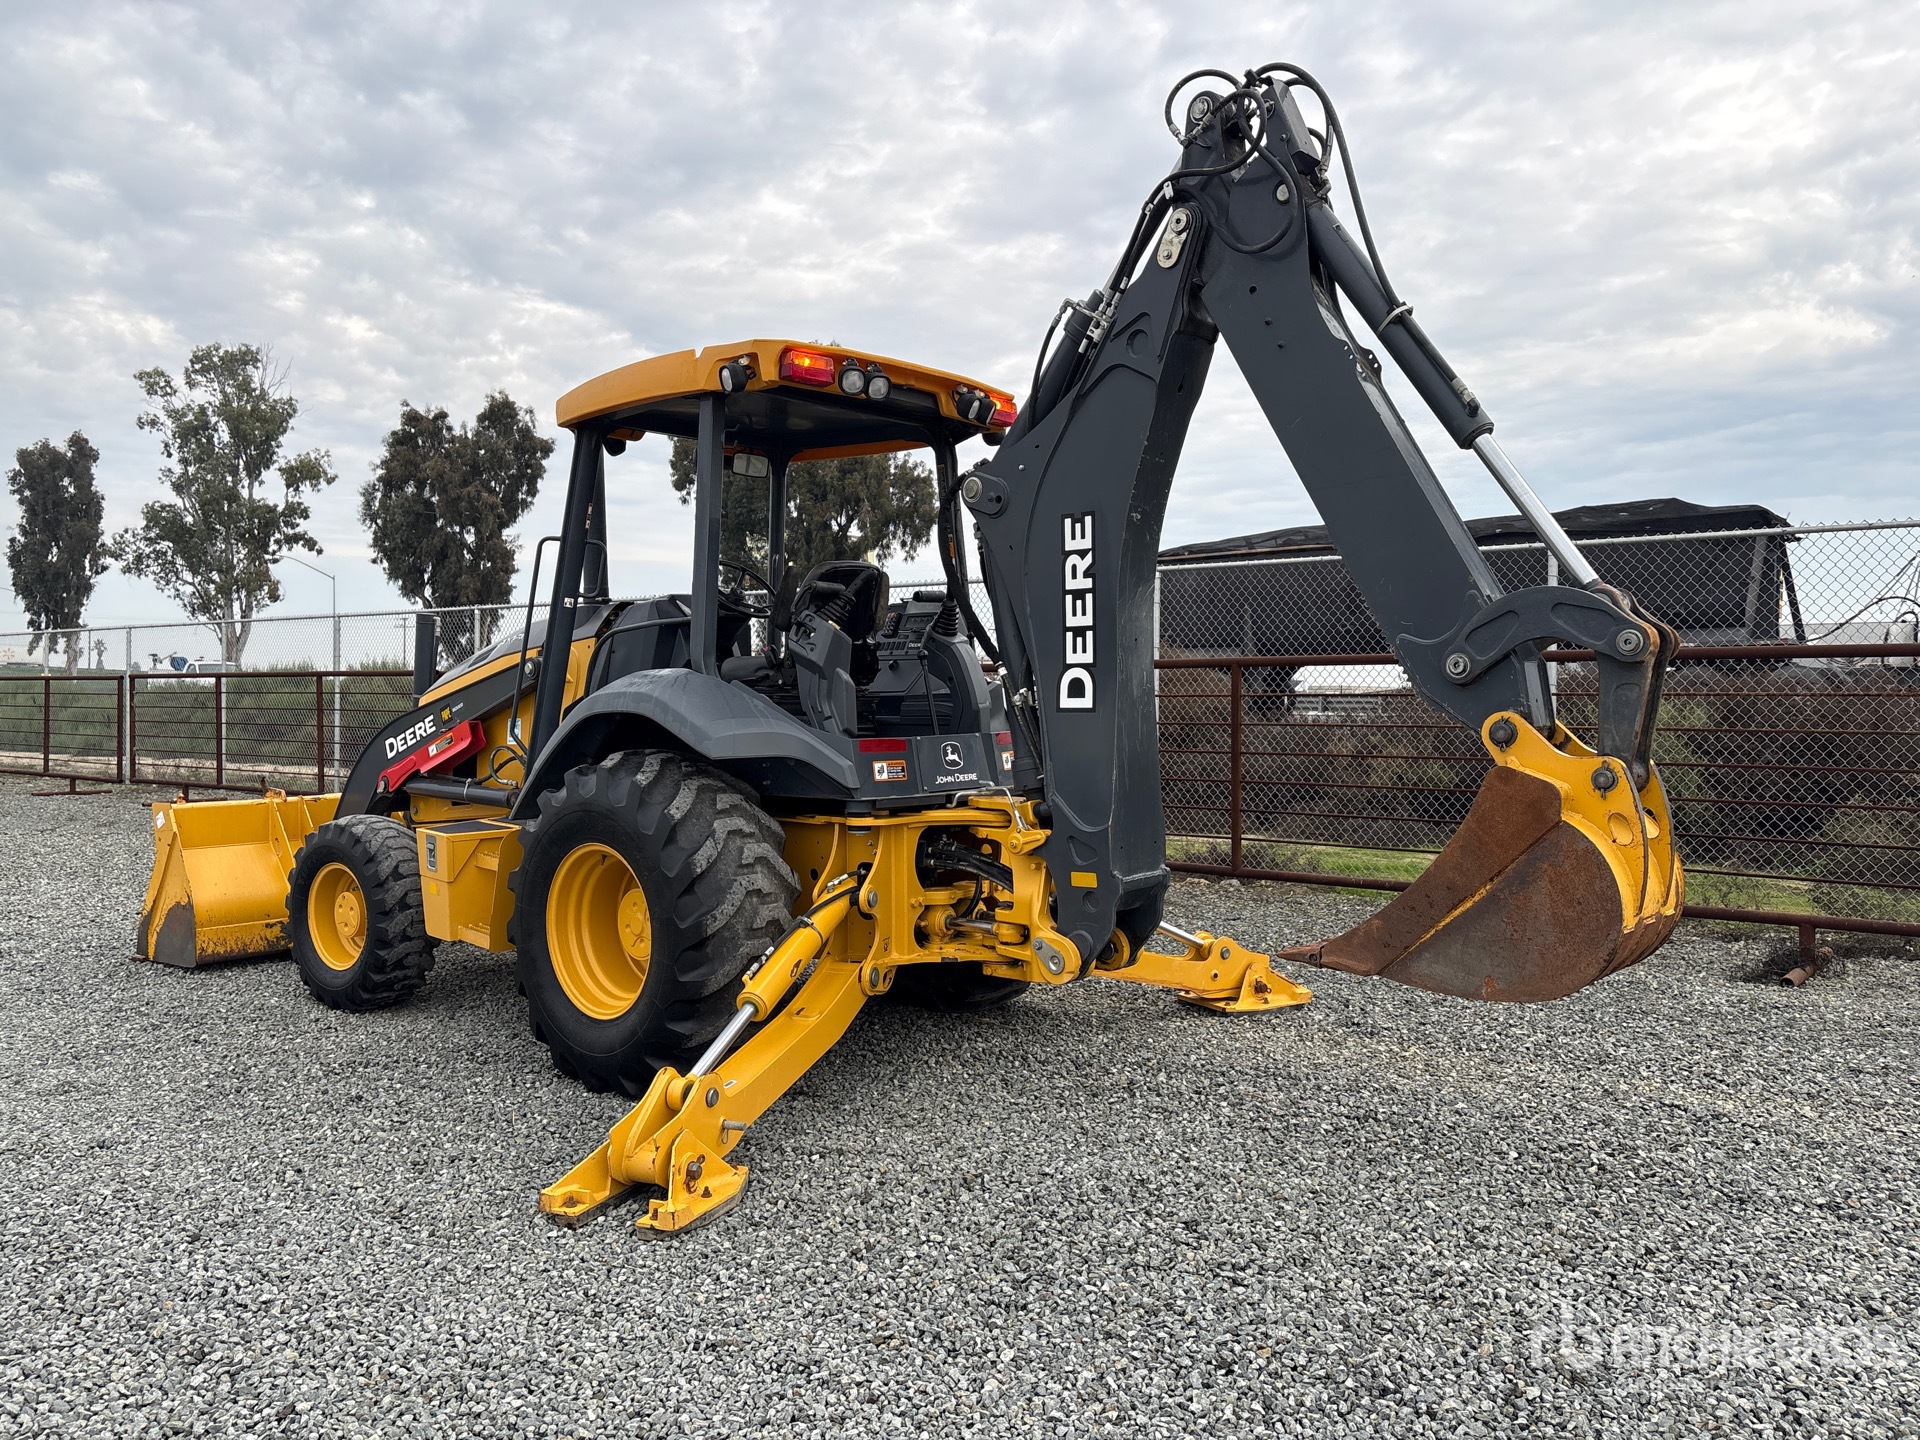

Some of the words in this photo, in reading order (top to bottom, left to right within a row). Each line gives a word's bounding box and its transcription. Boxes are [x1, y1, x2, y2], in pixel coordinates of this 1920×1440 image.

[1059, 515, 1094, 709] DEERE
[385, 714, 436, 759] DEERE
[935, 775, 955, 784] JOHN
[955, 773, 978, 782] DEERE
